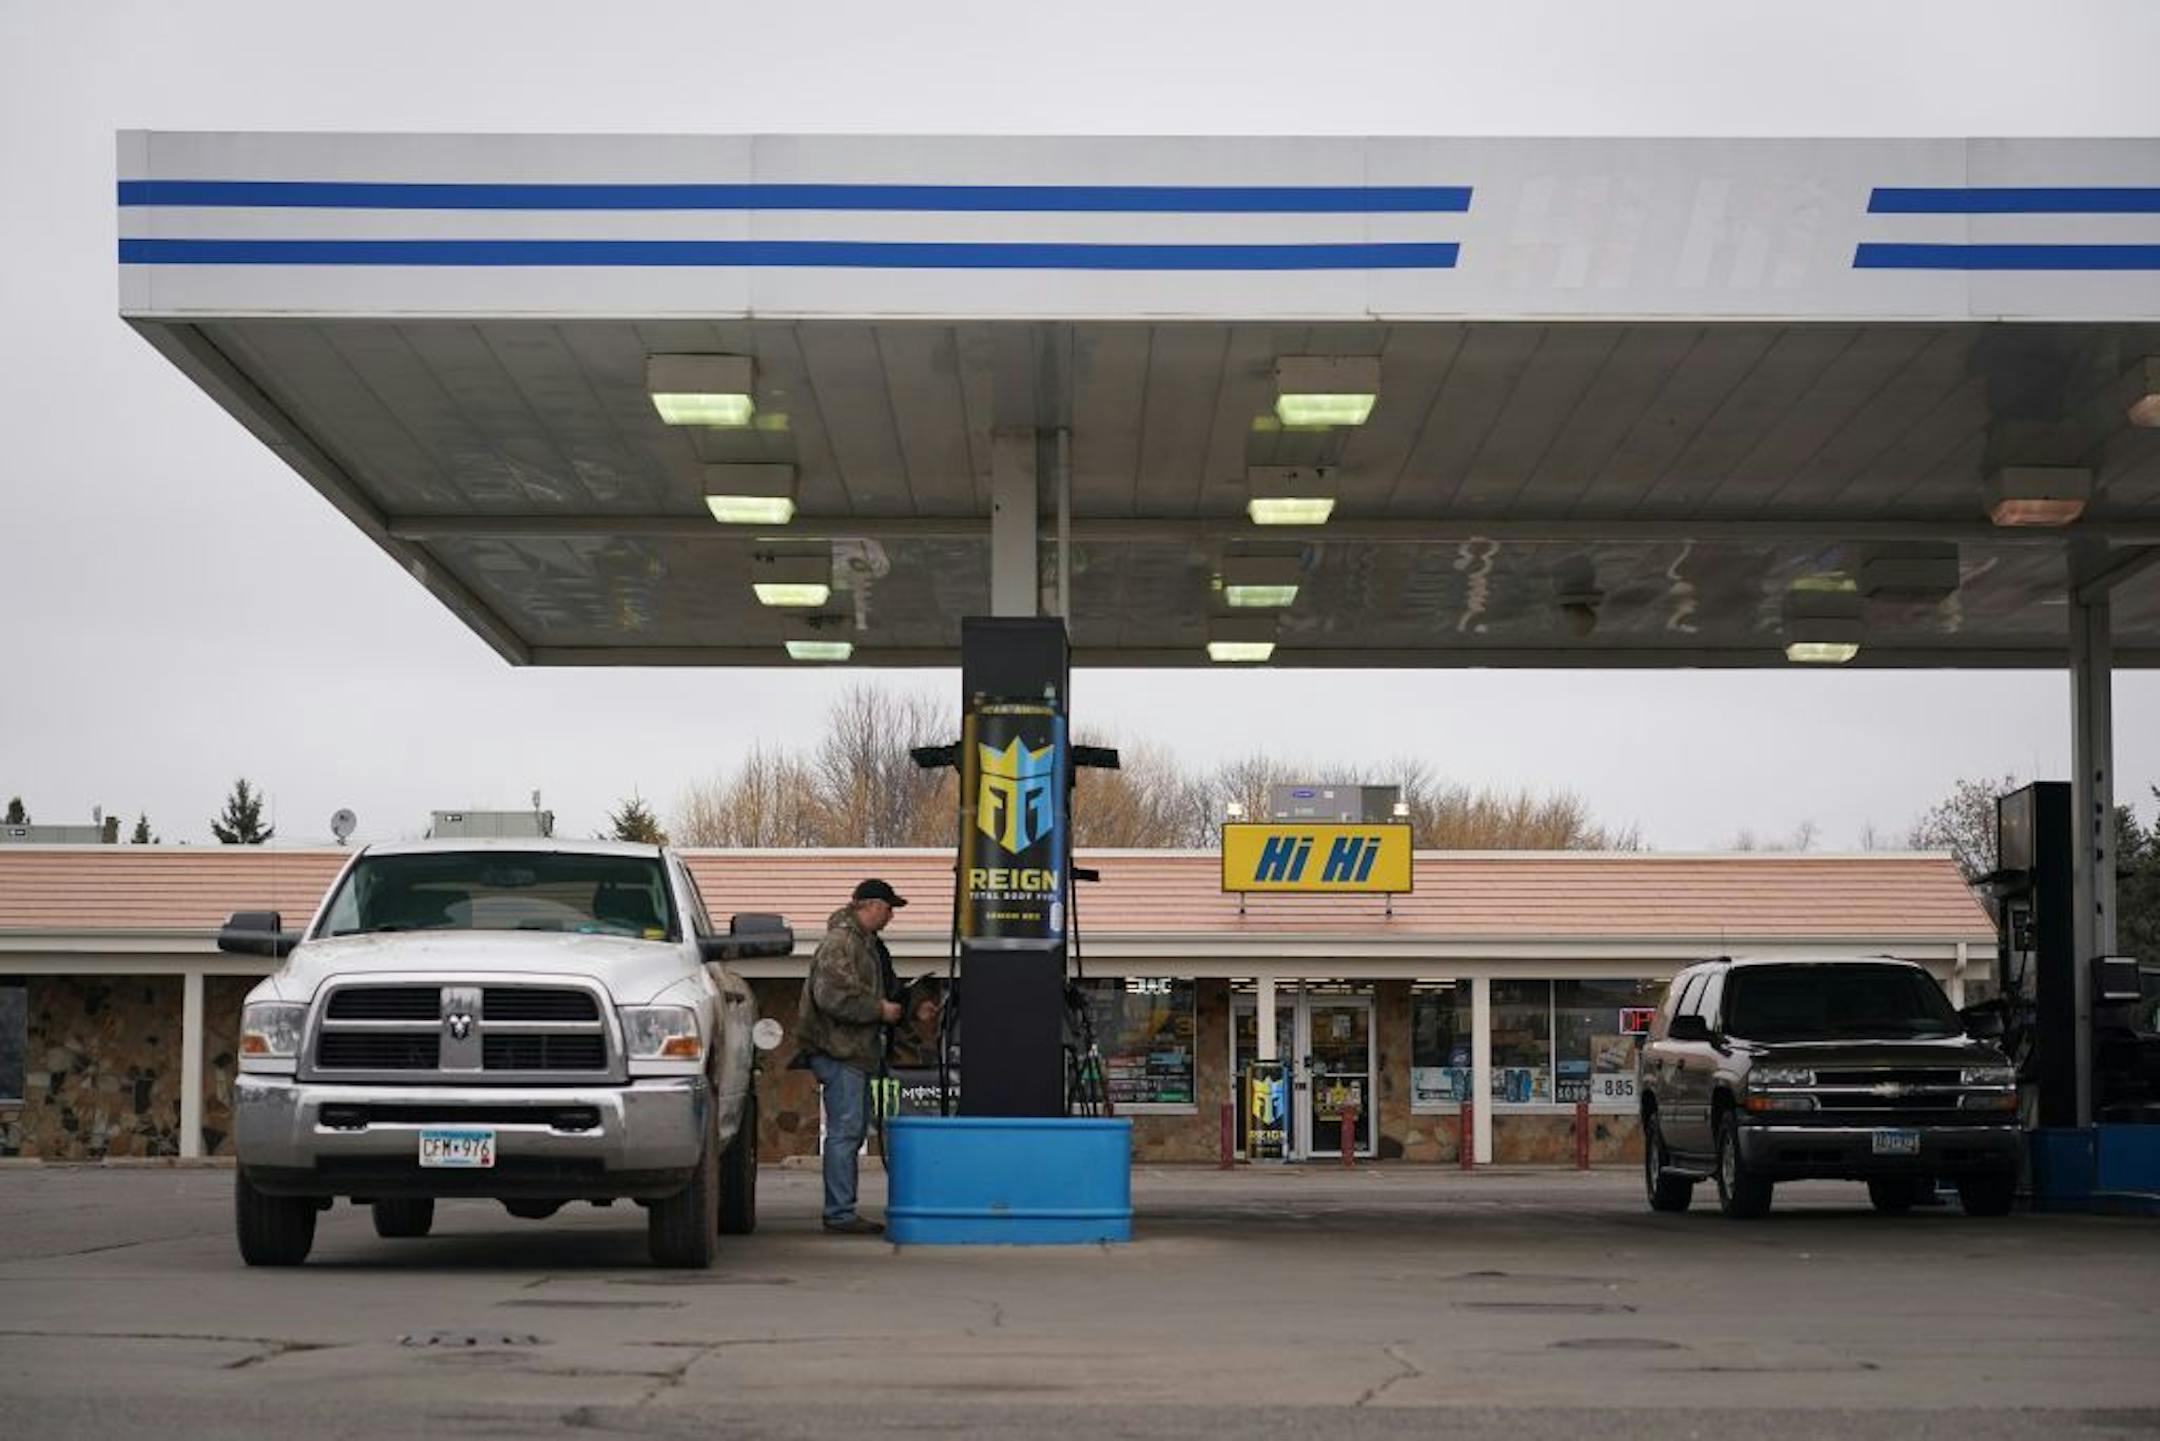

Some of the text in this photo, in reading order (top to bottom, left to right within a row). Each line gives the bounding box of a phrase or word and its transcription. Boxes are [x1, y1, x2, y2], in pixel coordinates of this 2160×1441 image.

[1254, 837, 1382, 882] Hi Hi
[969, 868, 1059, 891] REIGN
[463, 1139, 490, 1157] 976
